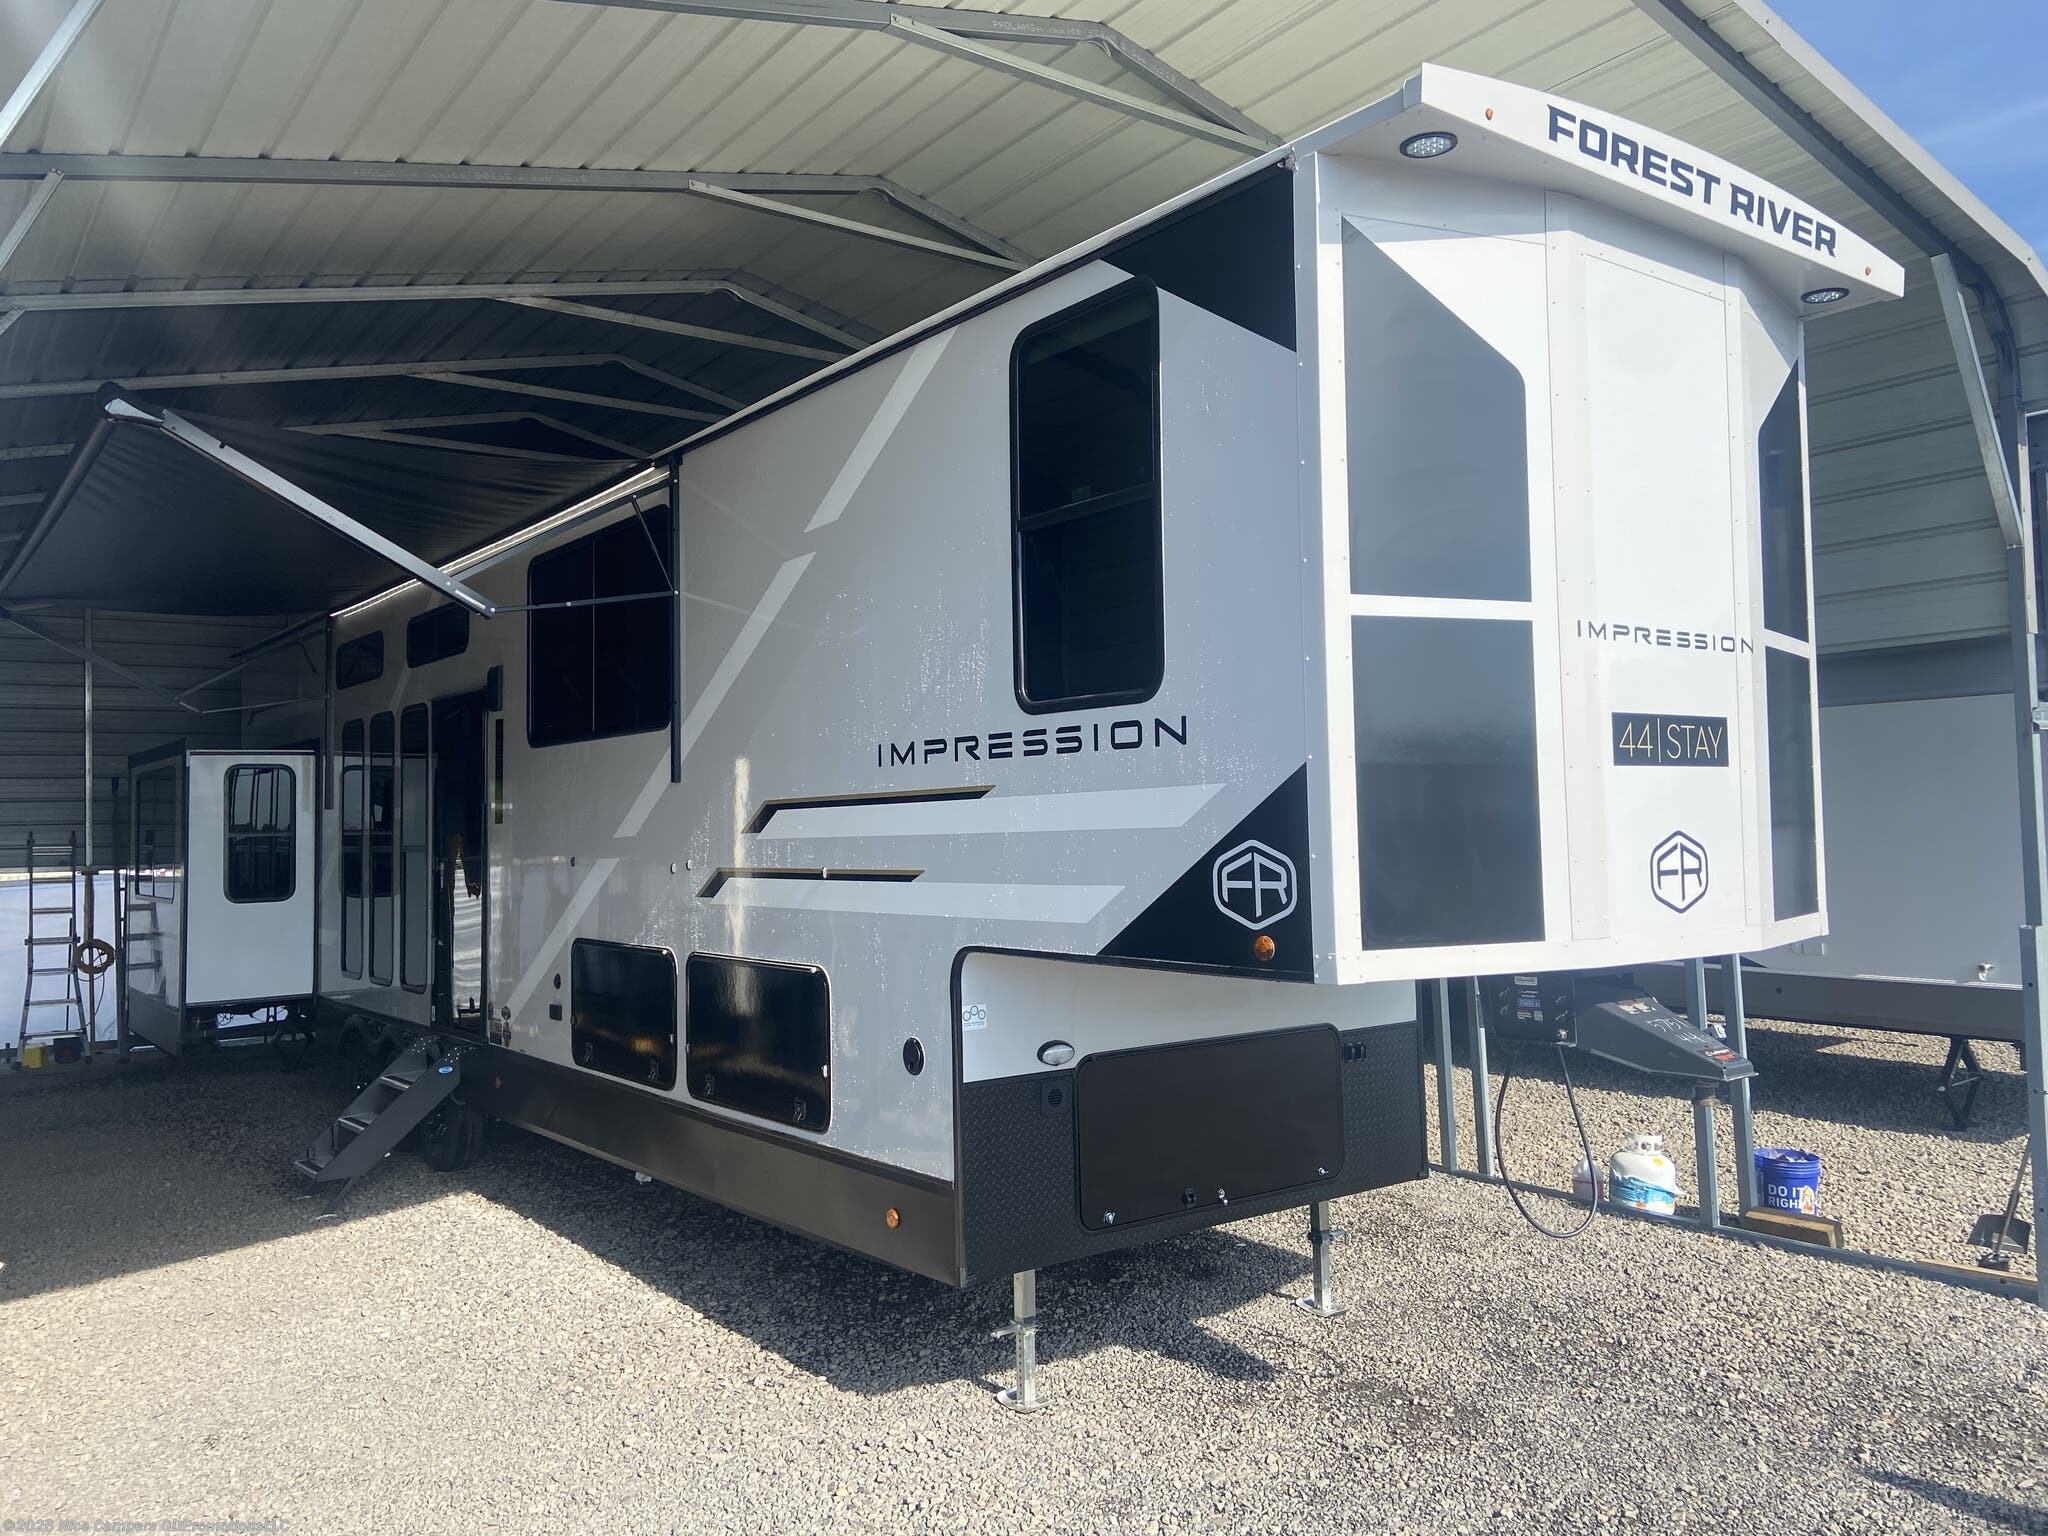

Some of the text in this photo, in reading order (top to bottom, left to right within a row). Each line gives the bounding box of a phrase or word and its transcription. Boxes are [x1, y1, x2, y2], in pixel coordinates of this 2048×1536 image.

[1547, 104, 1837, 258] FOREST RIVER
[1577, 619, 1754, 654] IMPRESSION
[878, 715, 1188, 768] IMPRESSION
[1768, 1184, 1804, 1197] DO IT
